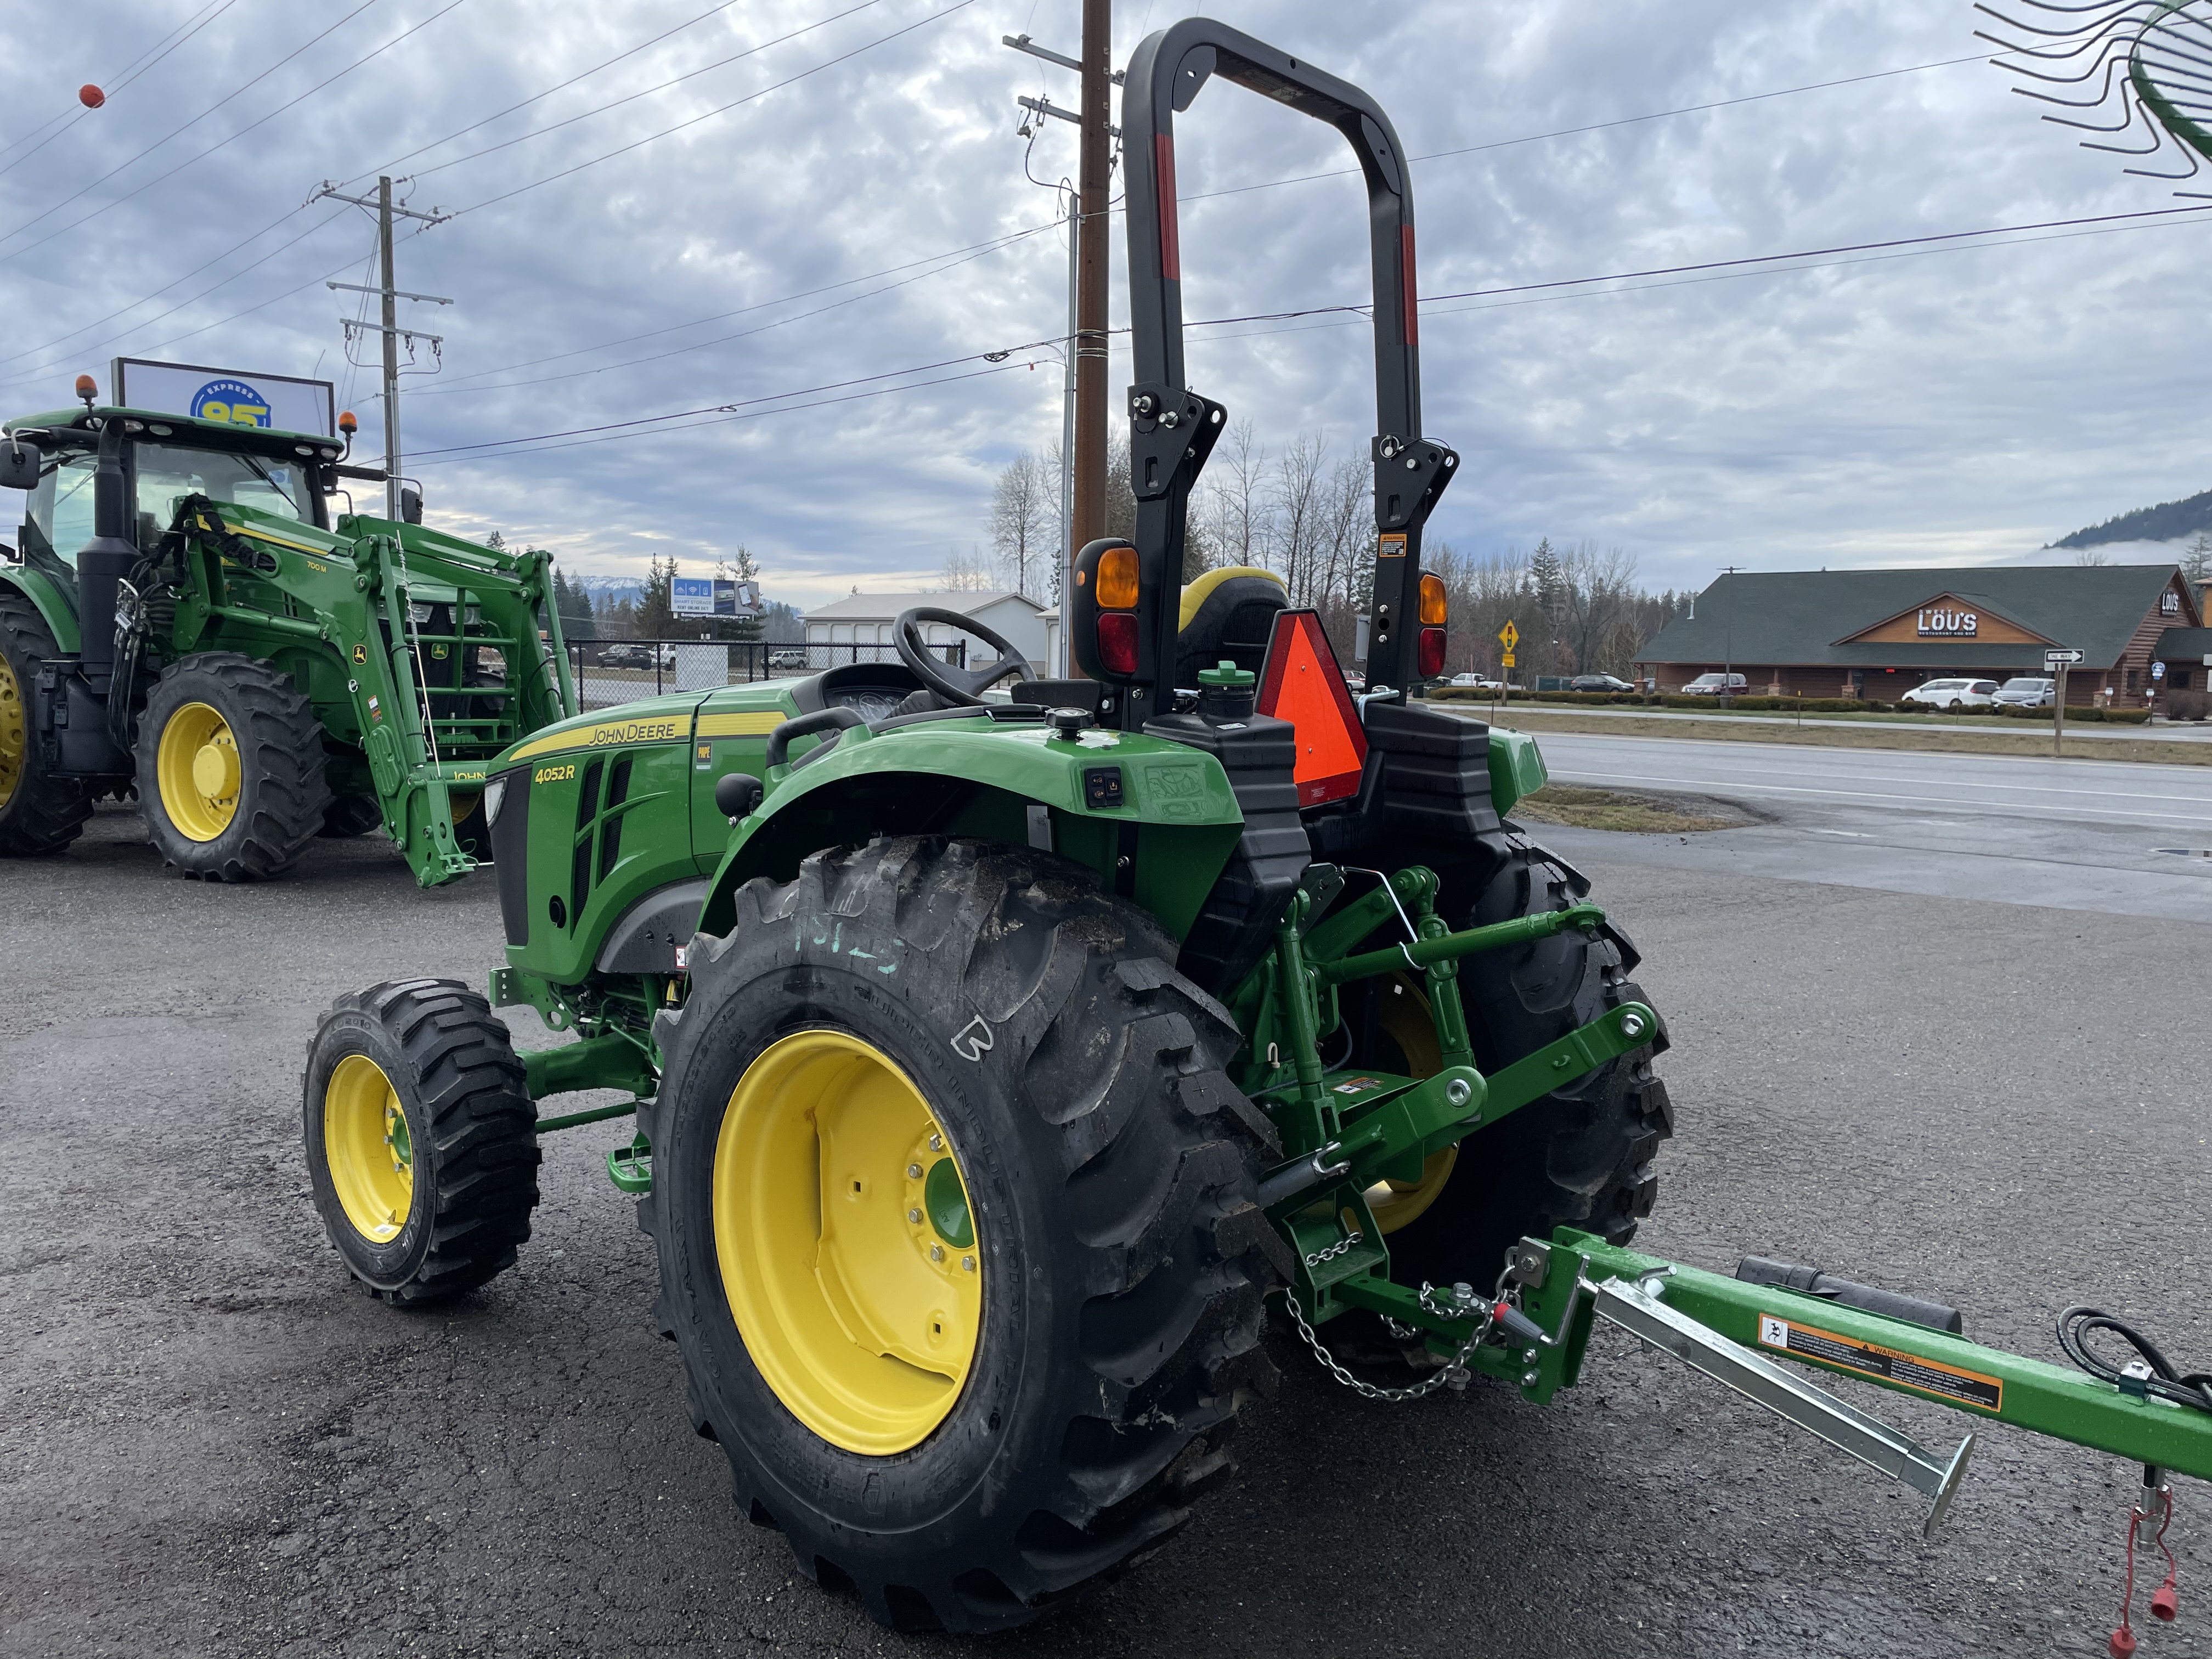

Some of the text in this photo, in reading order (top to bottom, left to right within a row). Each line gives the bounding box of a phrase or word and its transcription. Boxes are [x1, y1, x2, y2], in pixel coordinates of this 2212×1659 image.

[206, 383, 254, 399] EXPRESS
[202, 401, 267, 428] 95
[307, 561, 320, 572] 700
[1917, 612, 1977, 631] LOU'S
[589, 724, 675, 745] JOHN DEERE
[454, 771, 486, 781] JOHN
[950, 1014, 995, 1062] B
[947, 1073, 1020, 1347] INDUSTRIAL
[1874, 1346, 1915, 1363] WARNING
